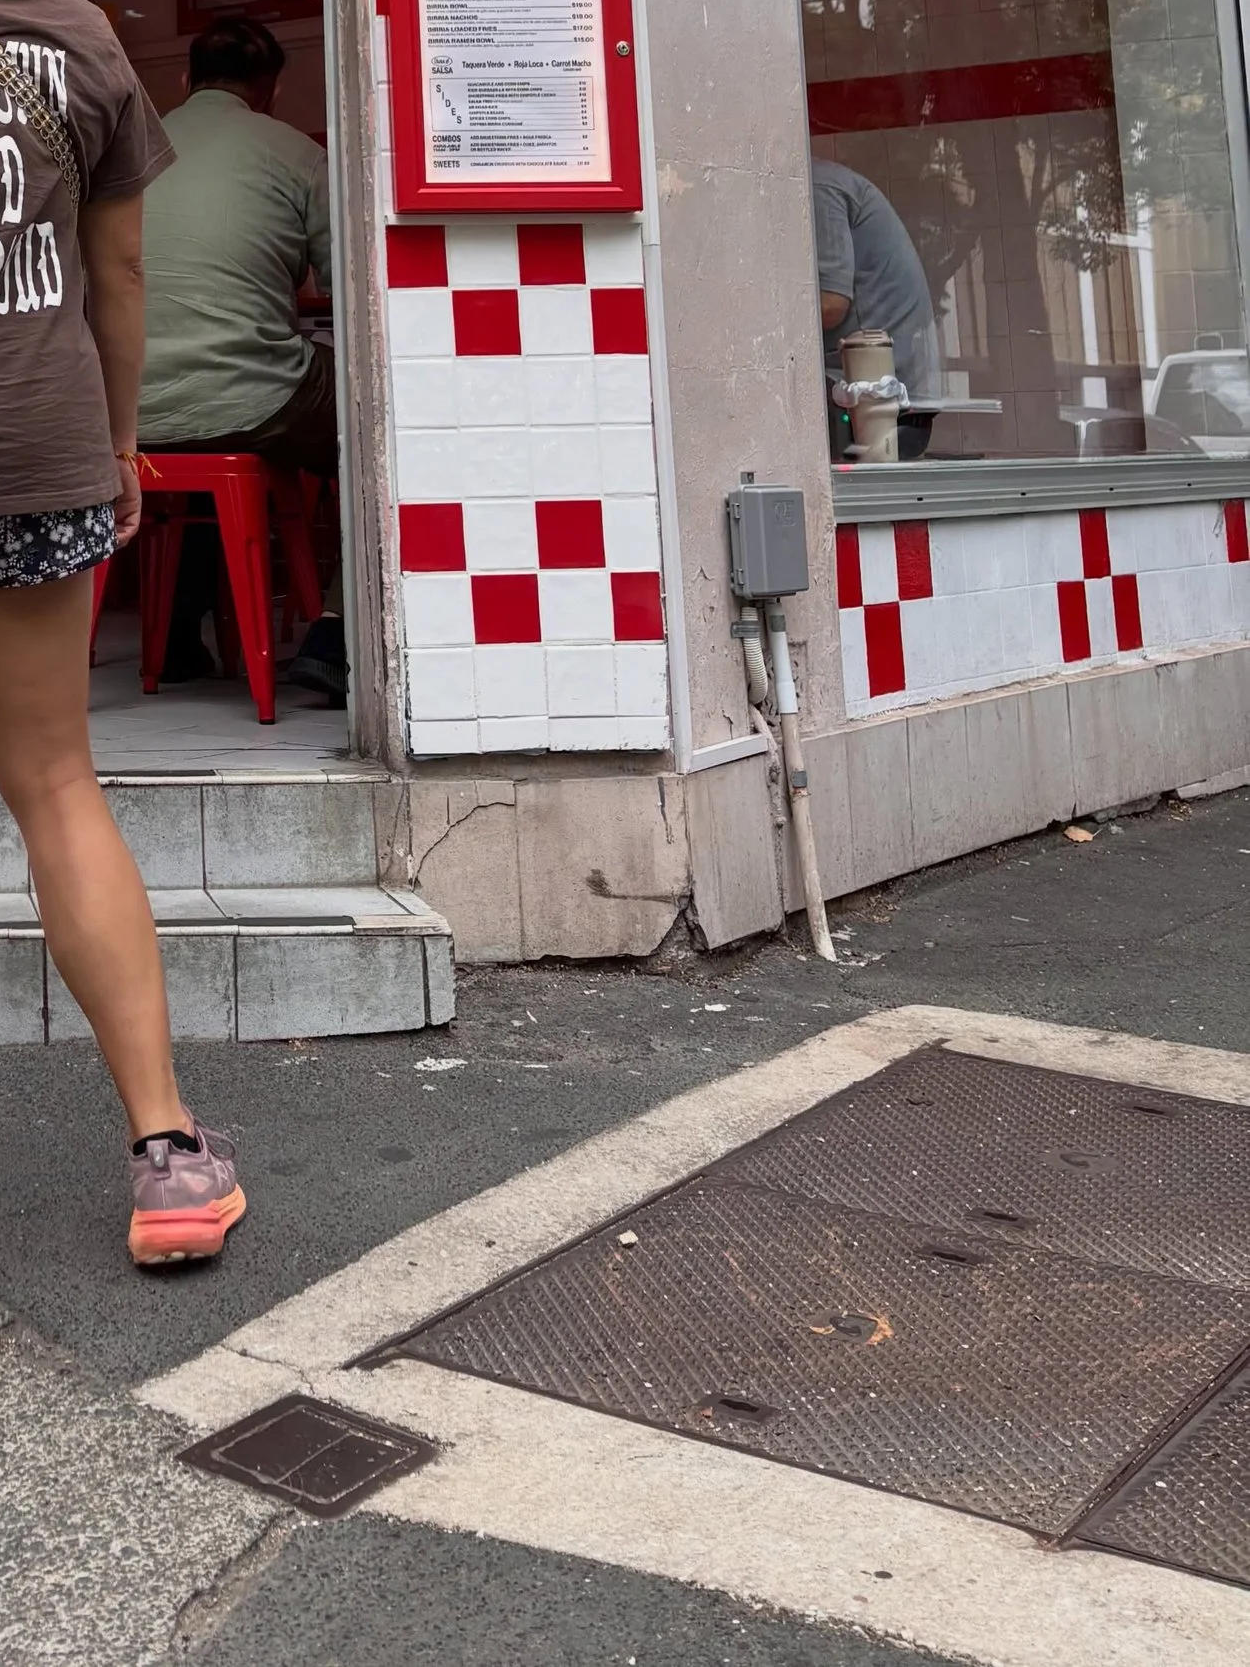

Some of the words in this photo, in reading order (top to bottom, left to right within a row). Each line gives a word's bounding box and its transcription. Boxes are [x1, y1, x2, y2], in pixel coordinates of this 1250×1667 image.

[514, 60, 528, 69] Roja
[529, 60, 544, 68] Loca
[571, 59, 592, 67] Macha
[431, 66, 453, 74] SALSA
[432, 134, 462, 142] COMBOS
[433, 160, 461, 169] SWEETS
